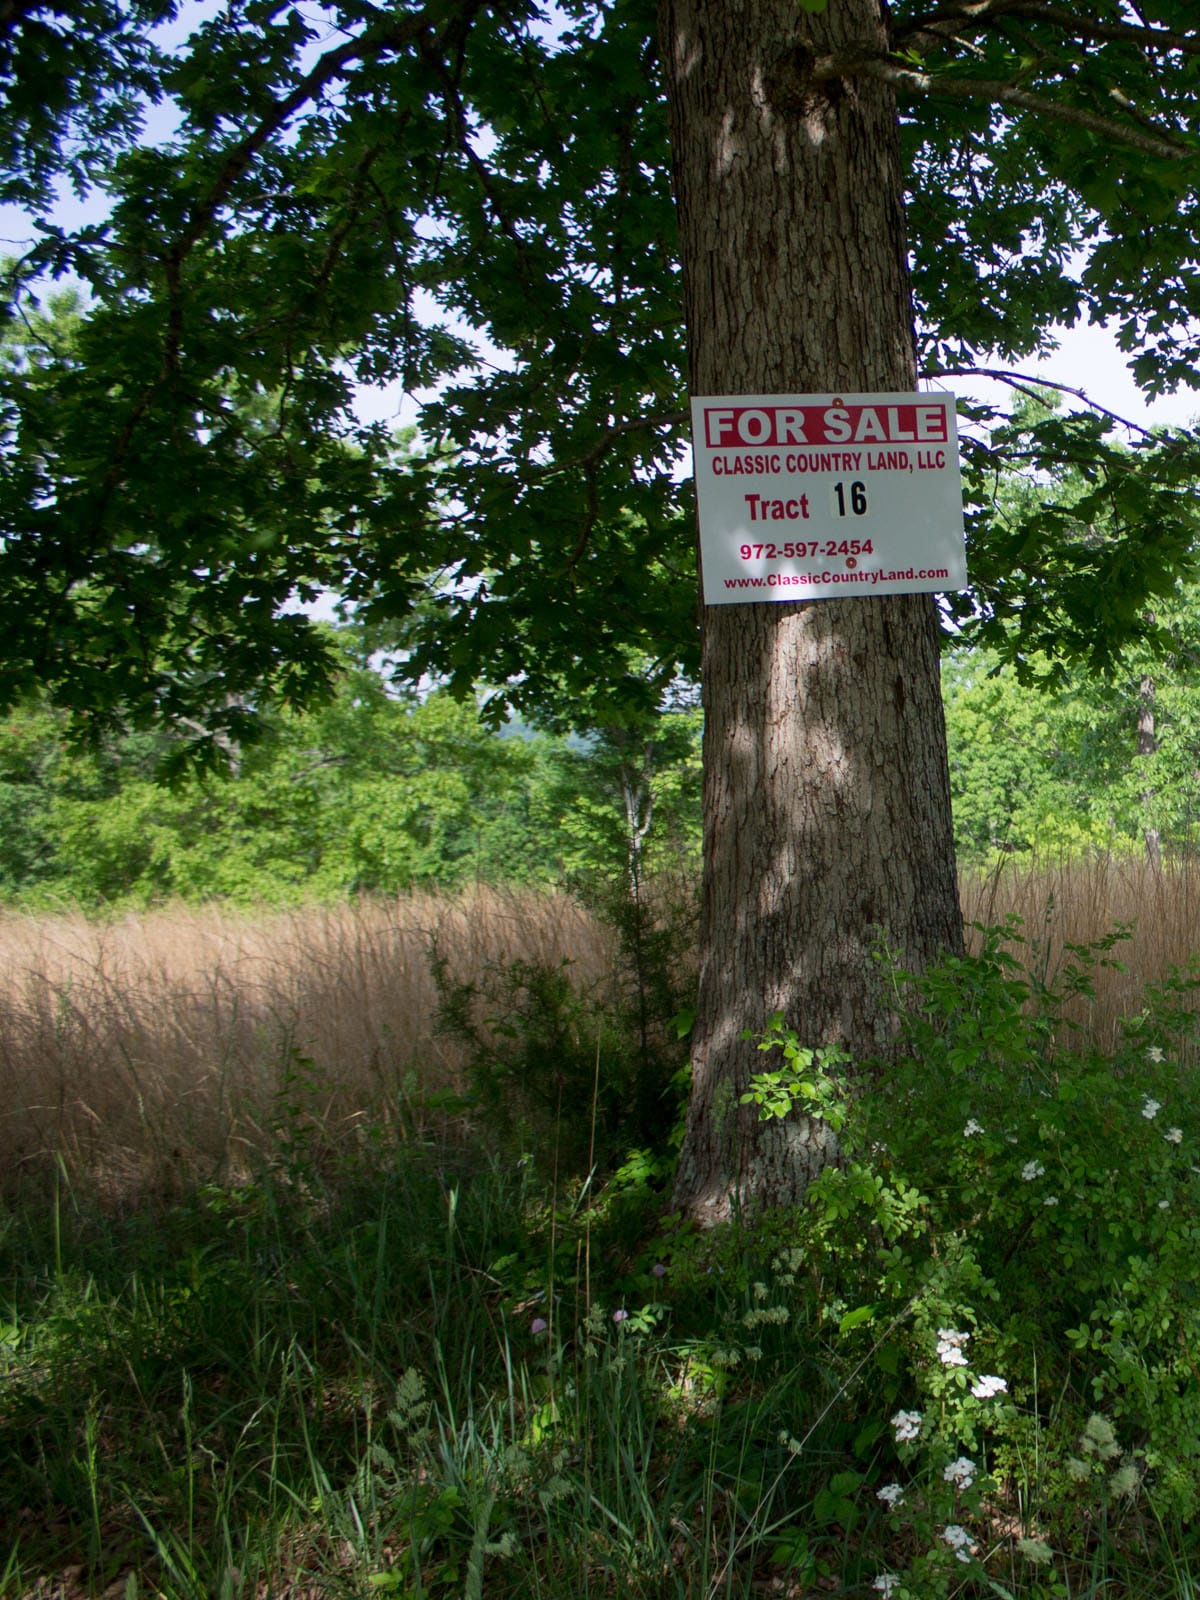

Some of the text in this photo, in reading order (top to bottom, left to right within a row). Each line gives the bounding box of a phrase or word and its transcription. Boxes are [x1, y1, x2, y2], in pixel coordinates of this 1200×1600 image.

[707, 406, 945, 446] FOR SALE
[712, 450, 946, 476] CLASSIC COUNTRY LAND, LLC
[744, 480, 868, 521] Tract 16
[740, 539, 874, 561] 972-597-2454
[724, 567, 949, 589] www.ClassicCountryLand.com
